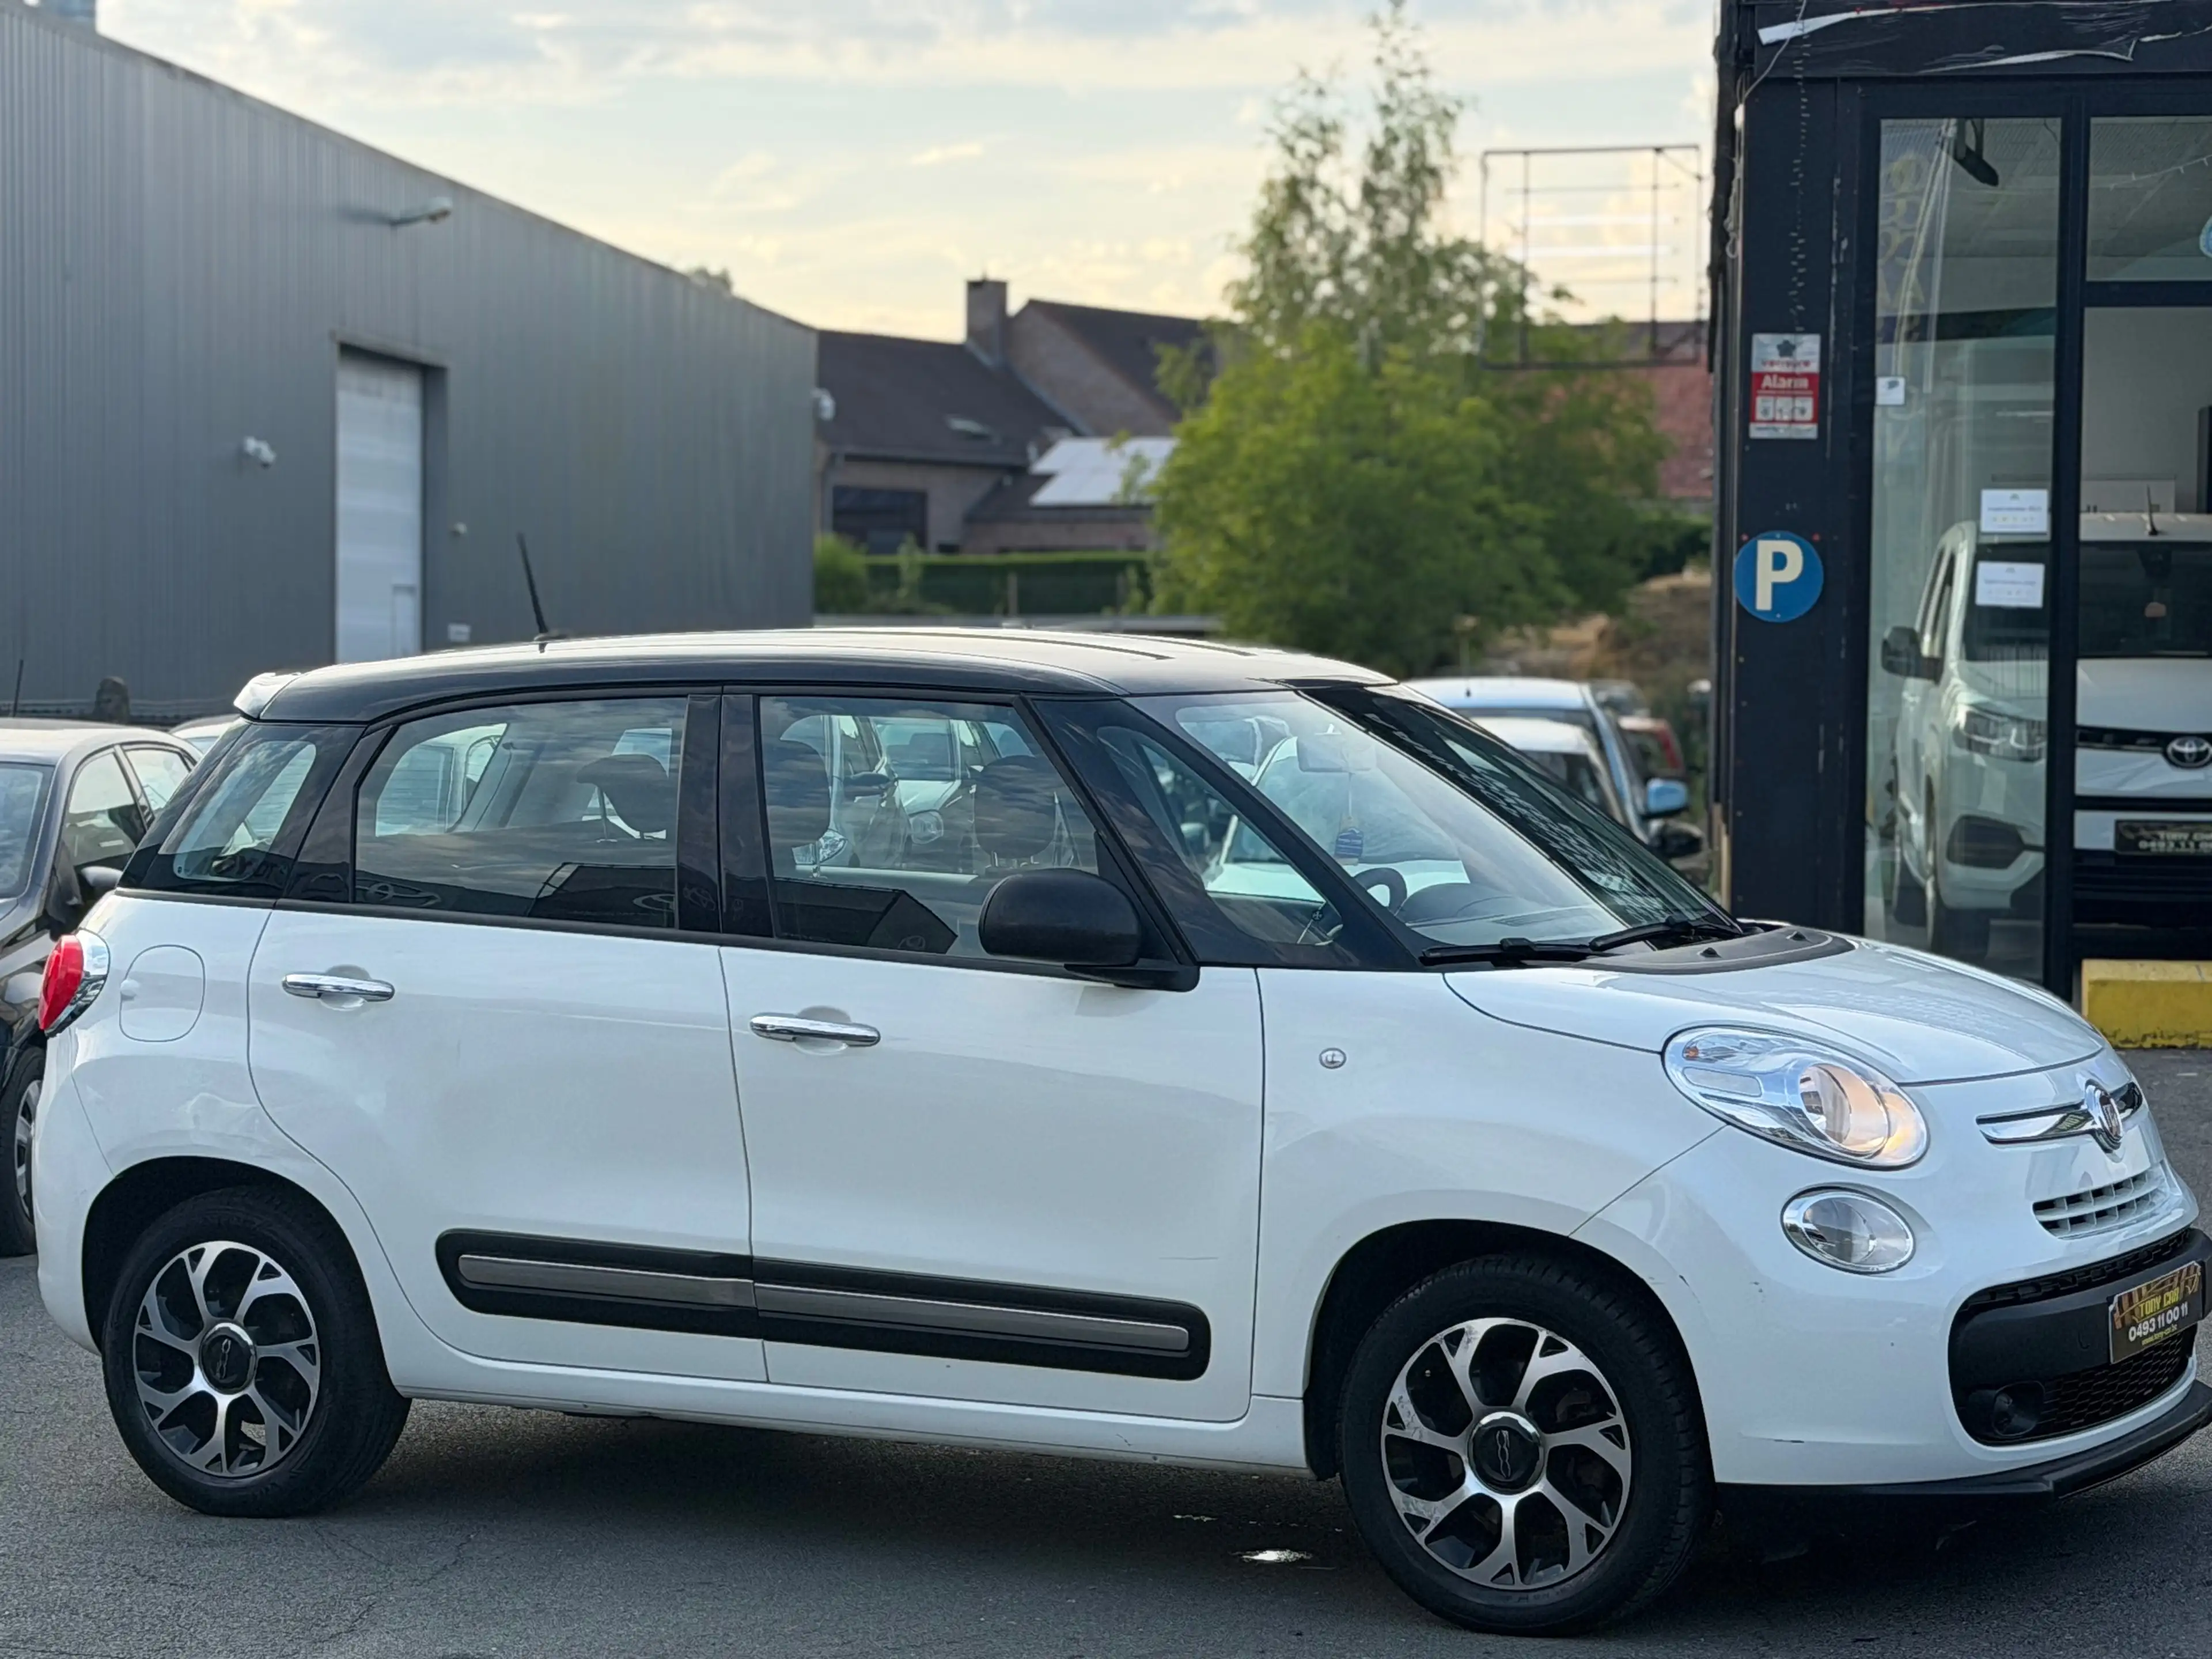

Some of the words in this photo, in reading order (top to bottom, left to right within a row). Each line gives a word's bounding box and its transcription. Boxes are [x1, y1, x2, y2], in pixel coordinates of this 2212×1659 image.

[1760, 374, 1809, 389] Alarm
[1756, 540, 1804, 611] P
[2129, 1317, 2156, 1342] 0493
[2158, 1313, 2165, 1328] 11
[2166, 1306, 2180, 1324] 00
[2181, 1301, 2188, 1317] 11
[2139, 1296, 2161, 1318] TONY
